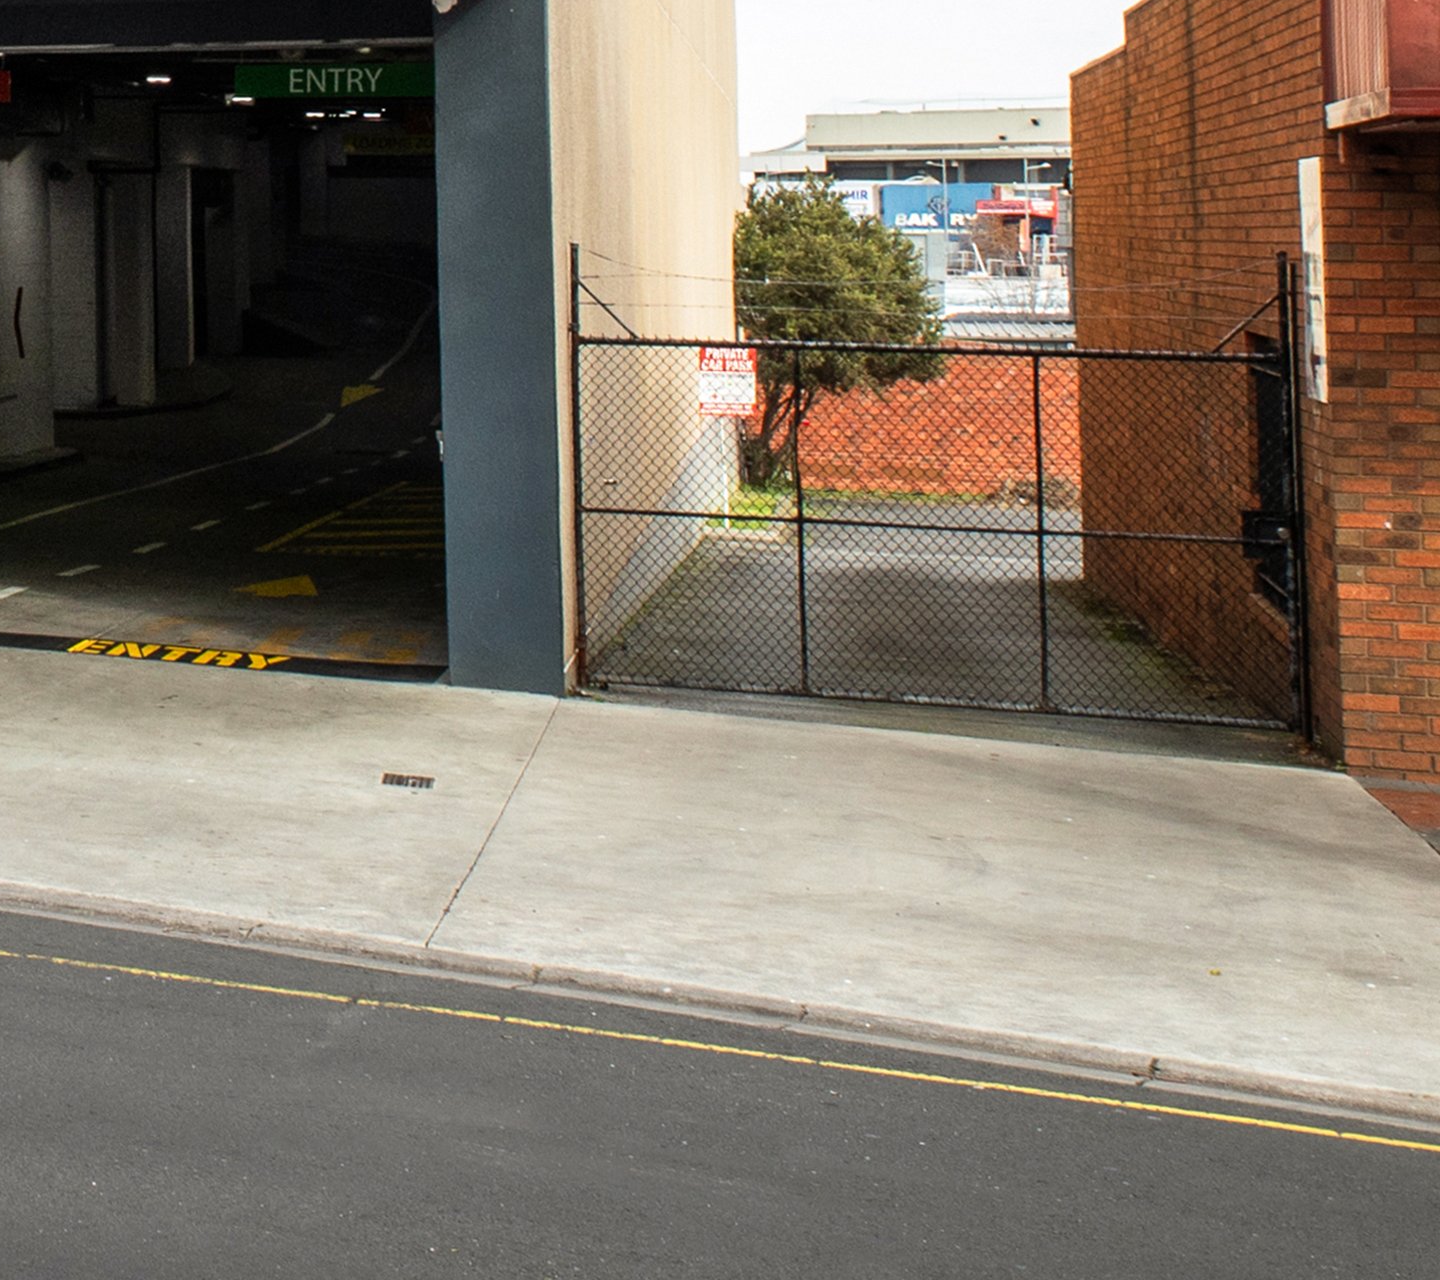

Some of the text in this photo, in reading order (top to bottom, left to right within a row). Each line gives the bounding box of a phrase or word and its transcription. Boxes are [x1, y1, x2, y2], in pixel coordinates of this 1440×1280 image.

[289, 68, 383, 93] ENTRY
[894, 212, 978, 227] BAKRY
[705, 347, 749, 360] PRIVATE
[701, 358, 753, 371] CAR PARK
[67, 638, 292, 670] ENTRY
